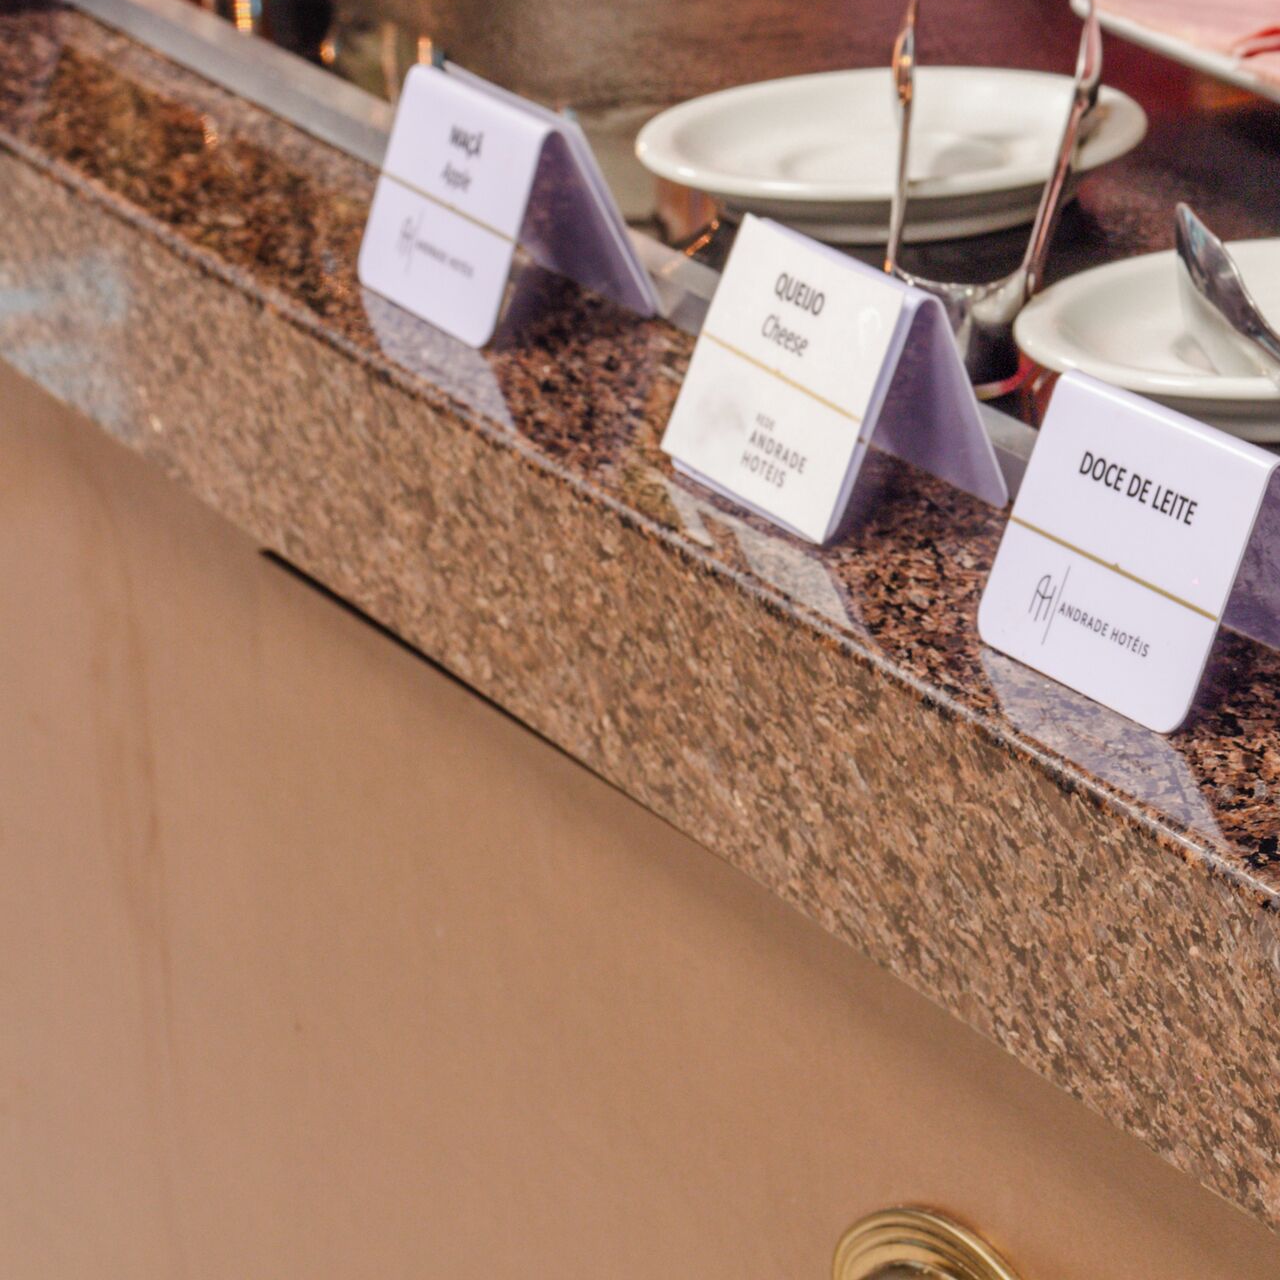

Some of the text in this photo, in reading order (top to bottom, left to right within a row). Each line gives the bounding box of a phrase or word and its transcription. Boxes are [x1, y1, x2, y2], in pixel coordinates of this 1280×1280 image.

[774, 273, 825, 317] QUEIJO
[762, 314, 809, 357] Cheese
[749, 430, 807, 475] ANDRADE
[1079, 450, 1198, 526] DOCE DE LEITE
[1058, 601, 1108, 638] ANDRADE
[1109, 624, 1150, 659] HOTÉIS
